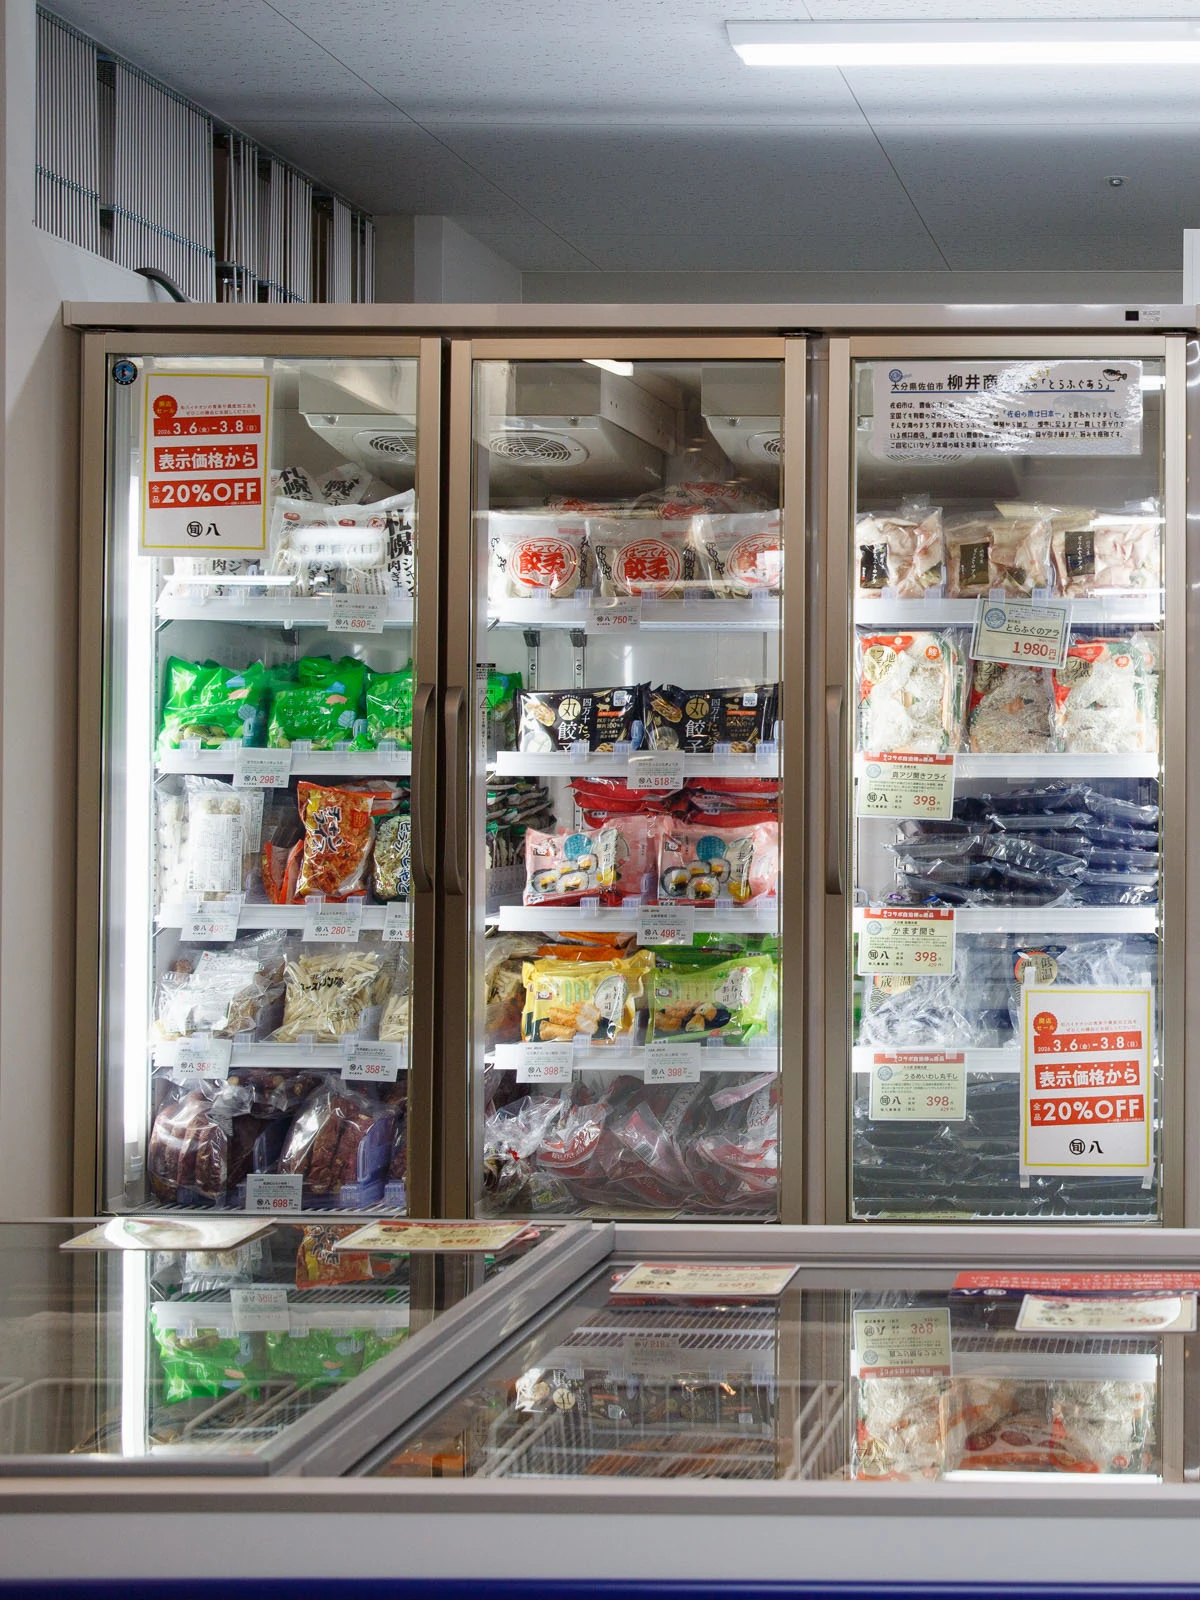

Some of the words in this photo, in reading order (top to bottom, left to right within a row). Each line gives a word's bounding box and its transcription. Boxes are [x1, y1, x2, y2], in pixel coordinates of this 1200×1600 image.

[892, 382, 944, 390] 大分県佐伯市
[1042, 379, 1110, 390] 「とらふぐあら」
[159, 452, 255, 470] 表示価格から
[162, 482, 256, 504] 20%OFF
[187, 521, 221, 537] 旬八
[351, 619, 366, 628] 630
[1006, 624, 1060, 636] とらふぐのアラ
[581, 698, 592, 723] 四万十
[710, 698, 720, 722] 四万十
[260, 775, 274, 784] 298
[892, 772, 947, 780] 真アジ開きフライ
[914, 795, 936, 806] 398
[331, 926, 346, 934] 280
[660, 930, 676, 938] 498
[892, 928, 936, 936] かます開き
[914, 952, 938, 962] 398
[365, 1064, 380, 1074] 358
[544, 1066, 558, 1076] 398
[668, 1068, 682, 1077] 398
[1040, 1068, 1138, 1088] 表示価格から
[926, 1096, 950, 1106] 398
[1043, 1099, 1140, 1122] 20%OFF
[1069, 1138, 1104, 1155] 旬八
[272, 1198, 288, 1208] 698
